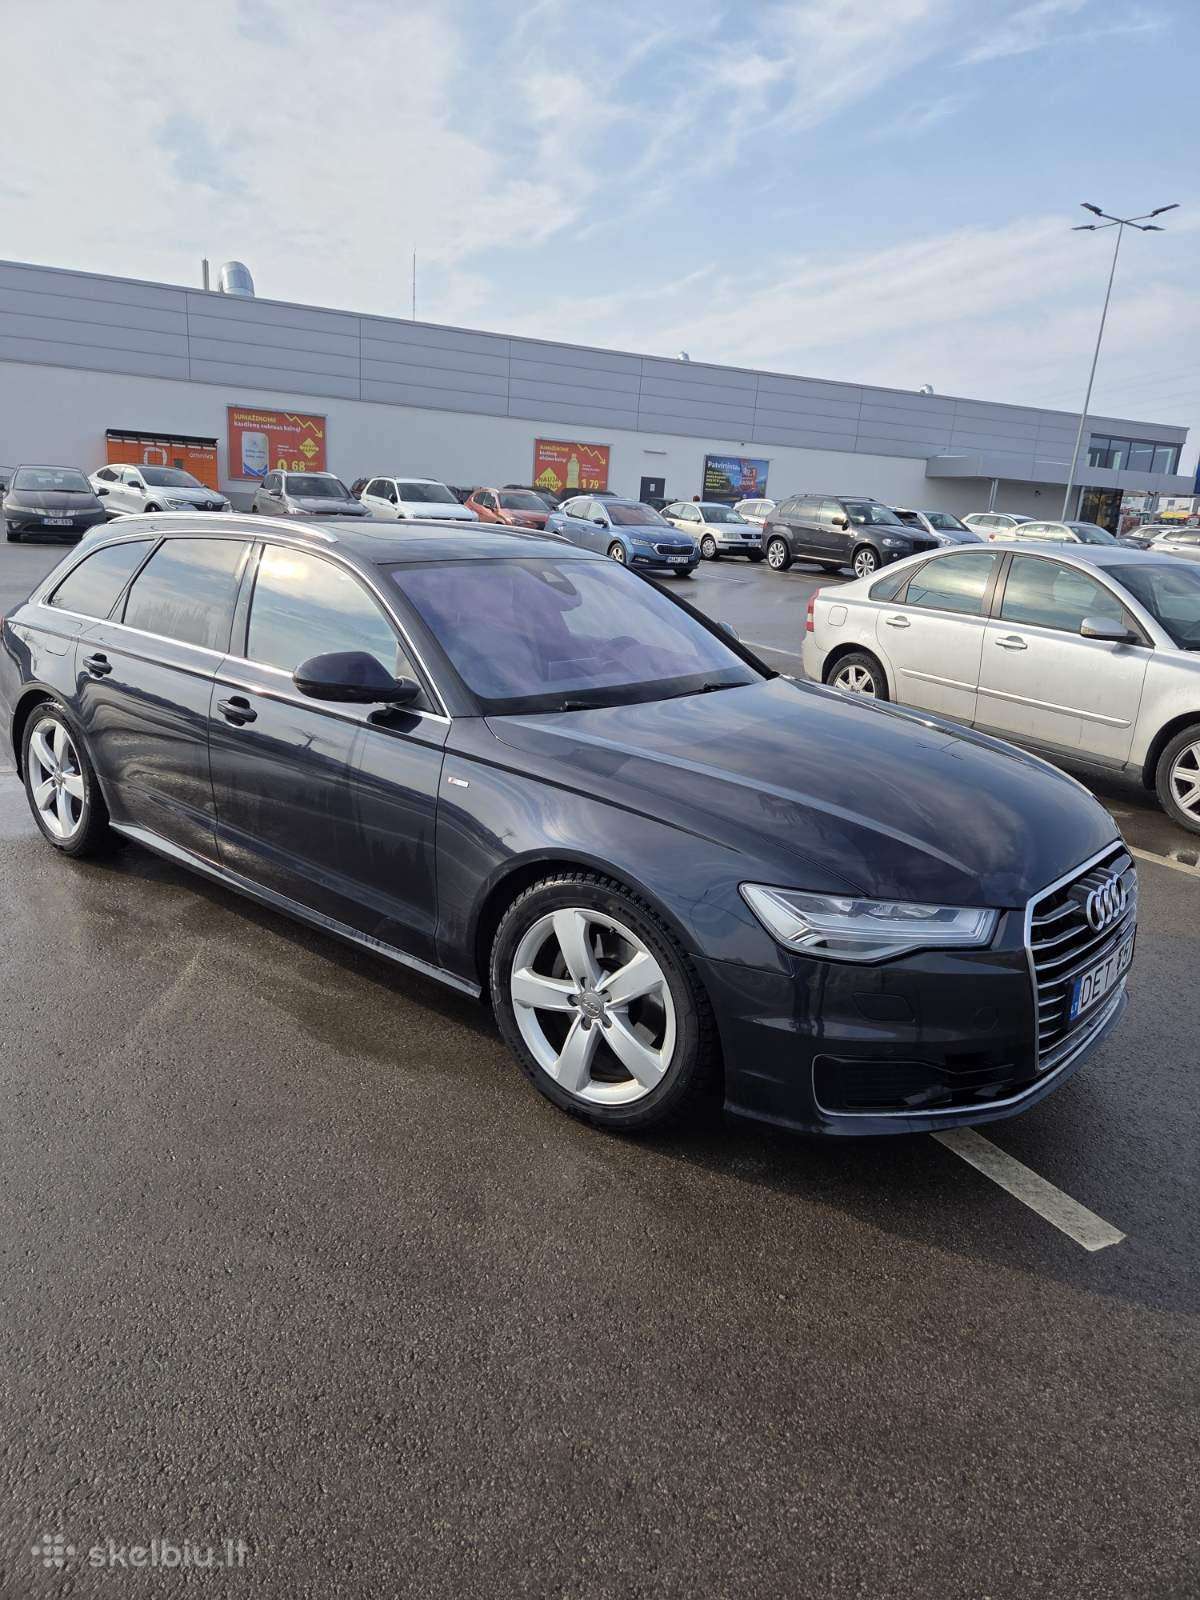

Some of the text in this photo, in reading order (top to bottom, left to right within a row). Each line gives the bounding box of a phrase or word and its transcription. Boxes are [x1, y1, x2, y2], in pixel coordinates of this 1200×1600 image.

[291, 460, 305, 472] 68
[590, 479, 599, 489] 79
[1081, 958, 1114, 1007] DET
